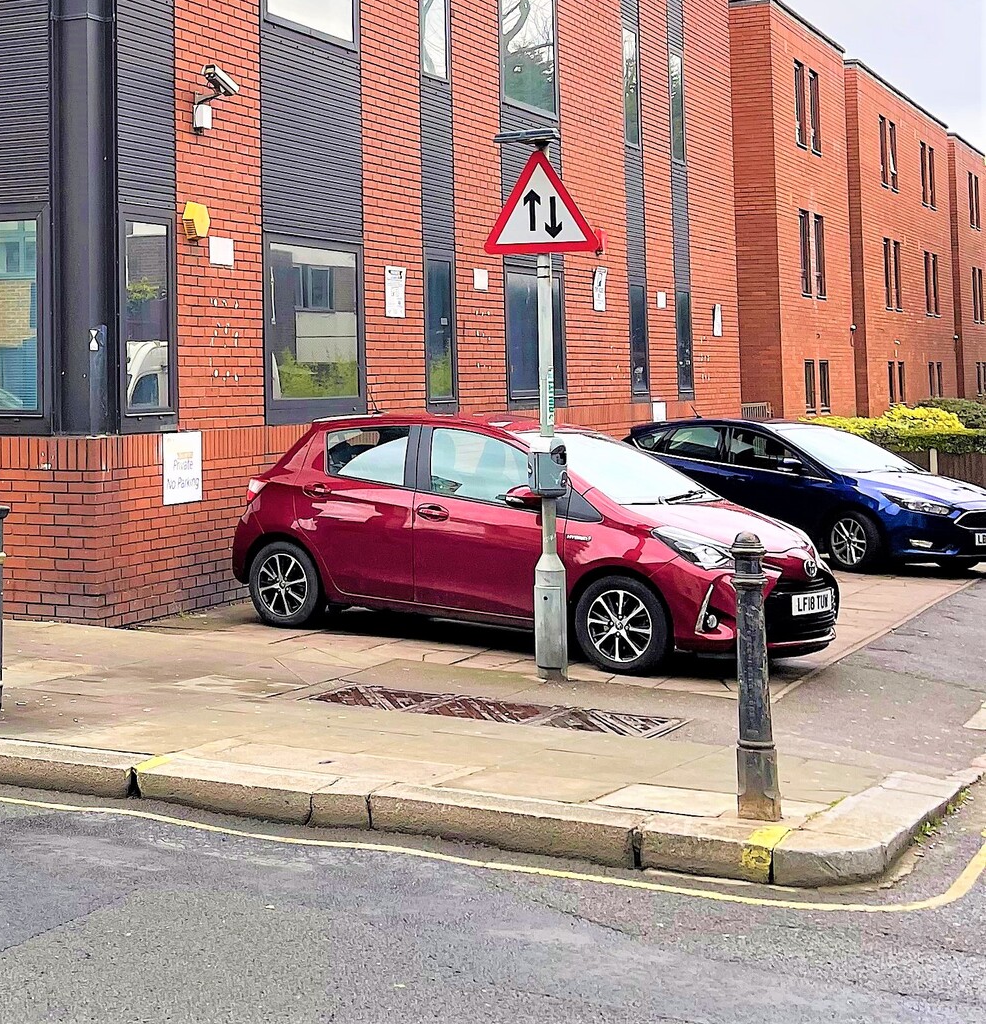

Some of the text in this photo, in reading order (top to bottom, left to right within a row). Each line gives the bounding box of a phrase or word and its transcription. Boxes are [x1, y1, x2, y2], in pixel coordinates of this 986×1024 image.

[173, 459, 193, 471] Private
[167, 476, 200, 490] No Parking
[797, 596, 815, 612] LF18
